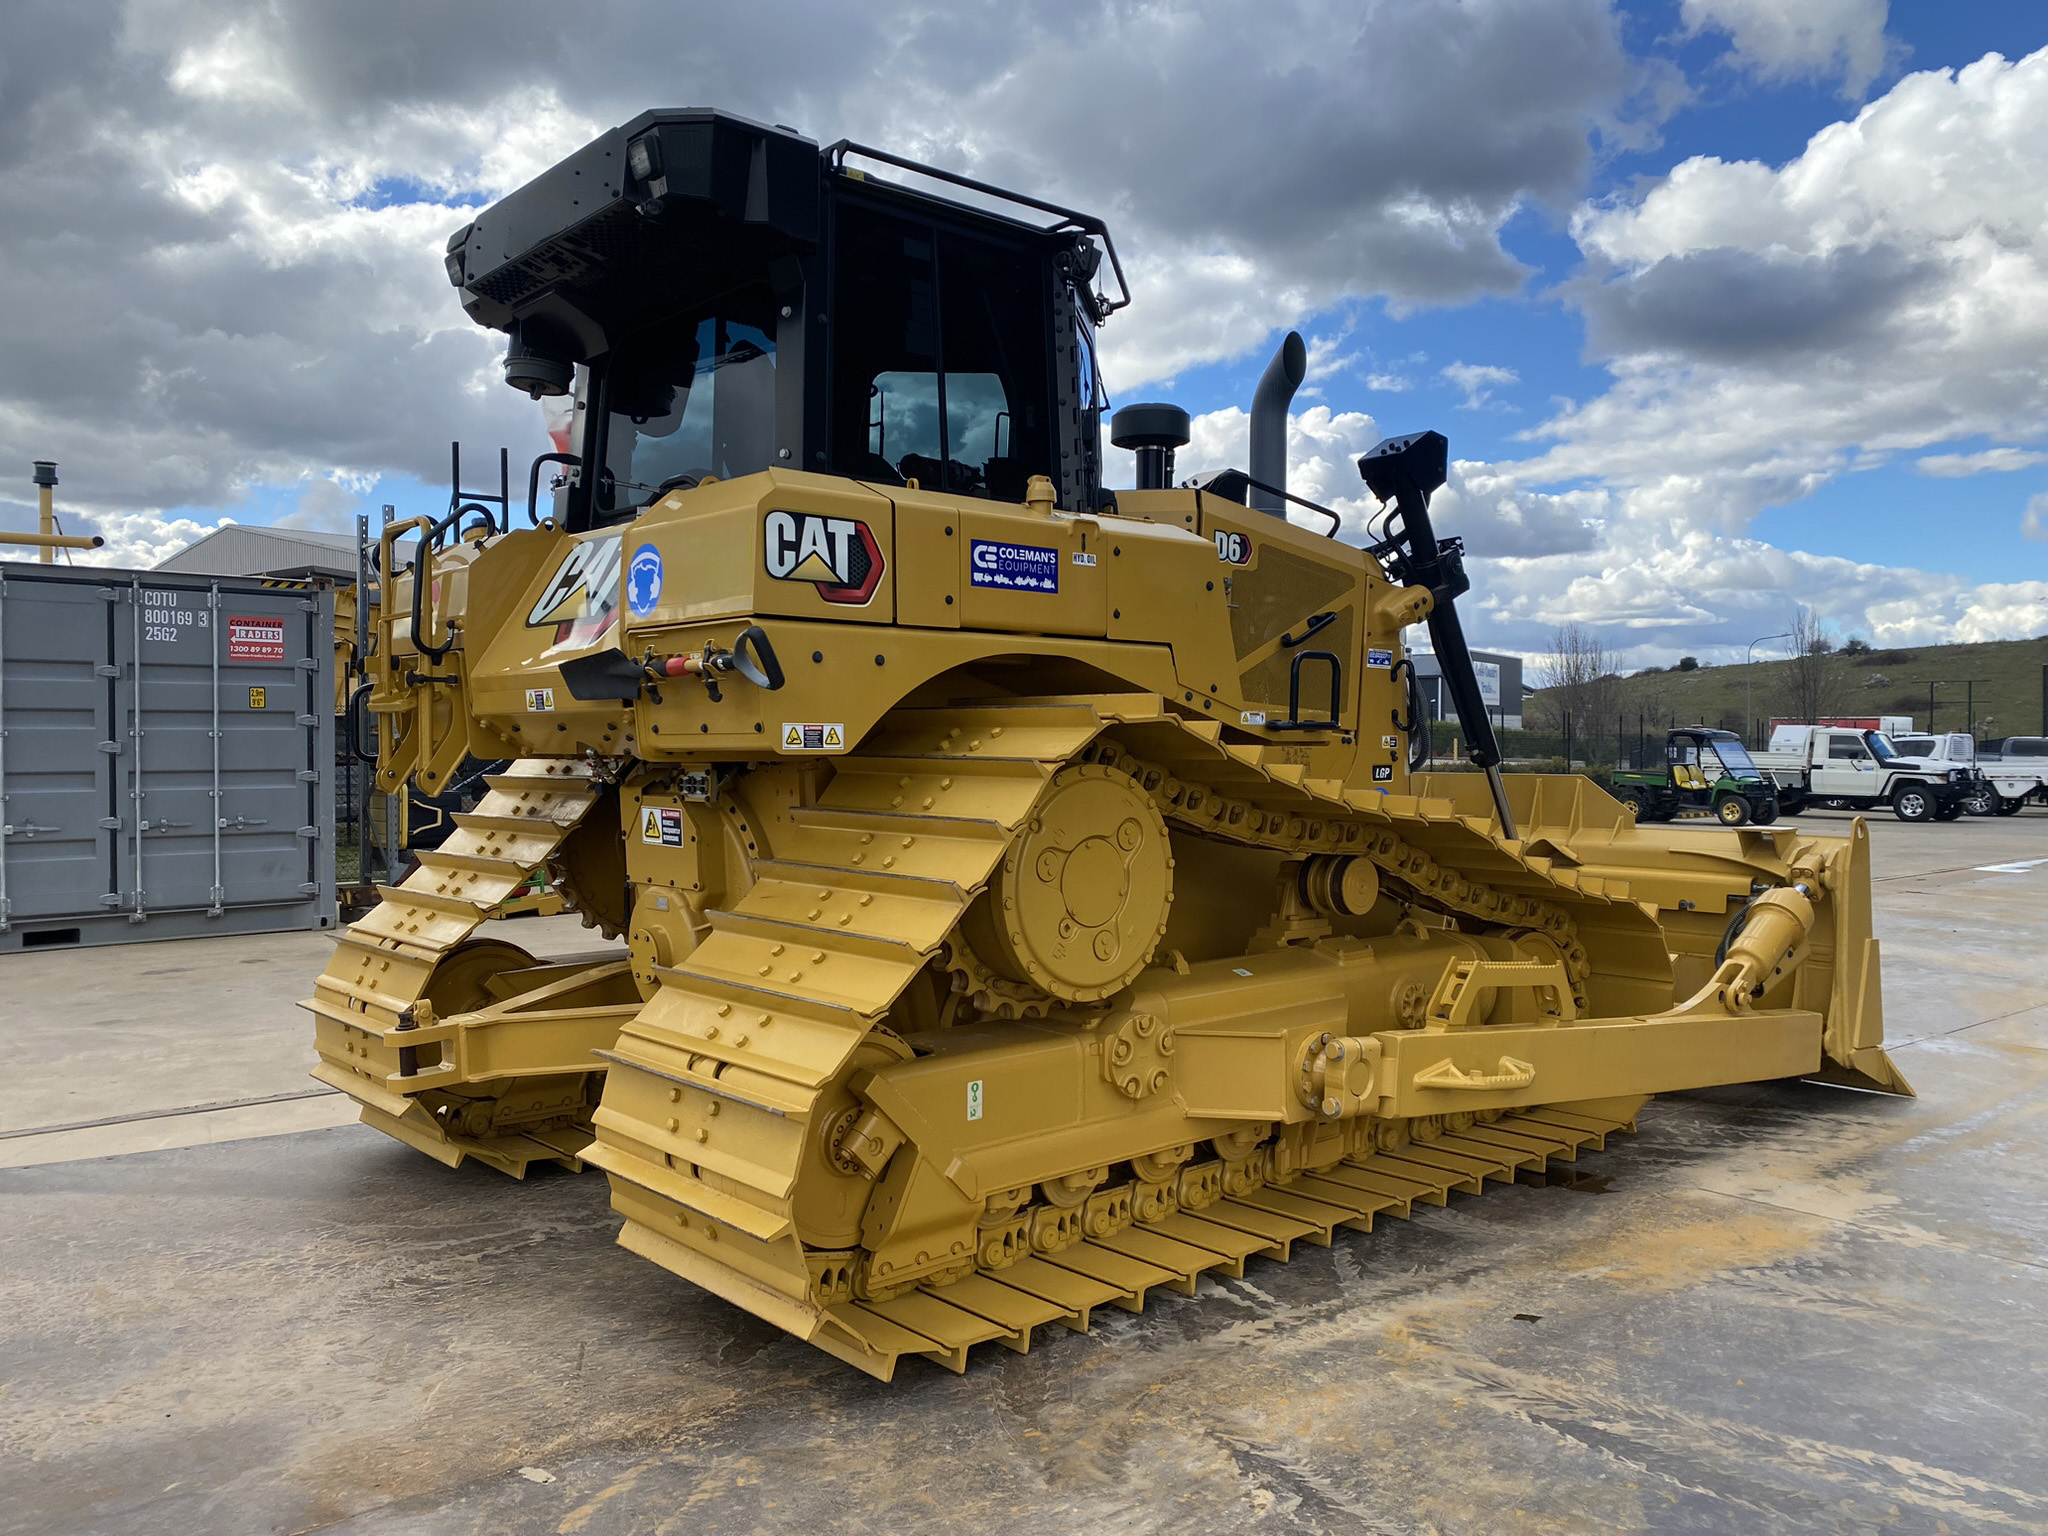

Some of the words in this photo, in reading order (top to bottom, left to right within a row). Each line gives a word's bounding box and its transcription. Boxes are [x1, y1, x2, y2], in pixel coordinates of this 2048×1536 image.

[764, 511, 856, 584] CAT
[1215, 531, 1241, 562] D6
[999, 547, 1056, 564] COLEMAN'S
[998, 560, 1056, 575] EQUIPMENT
[144, 591, 177, 607] COTU
[144, 609, 193, 625] 800169
[229, 619, 284, 628] CONTAINER
[145, 626, 178, 642] 25G2
[232, 627, 280, 640] TRADERS
[1375, 767, 1391, 779] LGP
